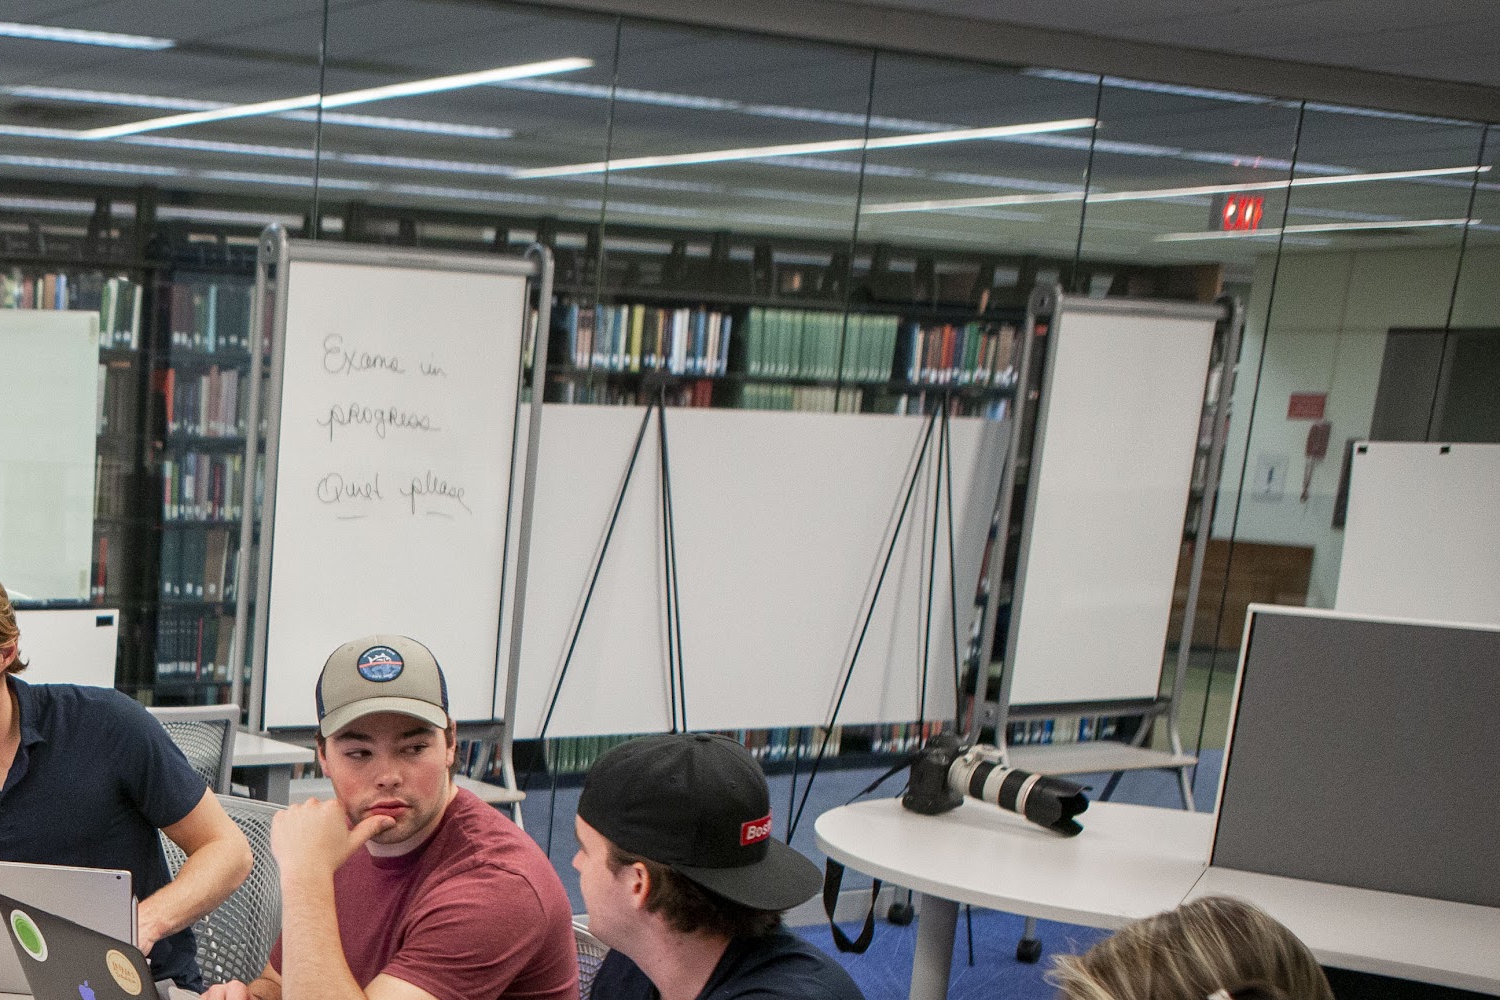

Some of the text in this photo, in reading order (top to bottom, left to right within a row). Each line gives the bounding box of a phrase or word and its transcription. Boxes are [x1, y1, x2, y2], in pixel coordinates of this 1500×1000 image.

[323, 333, 448, 378] Exams in
[317, 402, 442, 443] progress
[317, 472, 384, 504] Quiet
